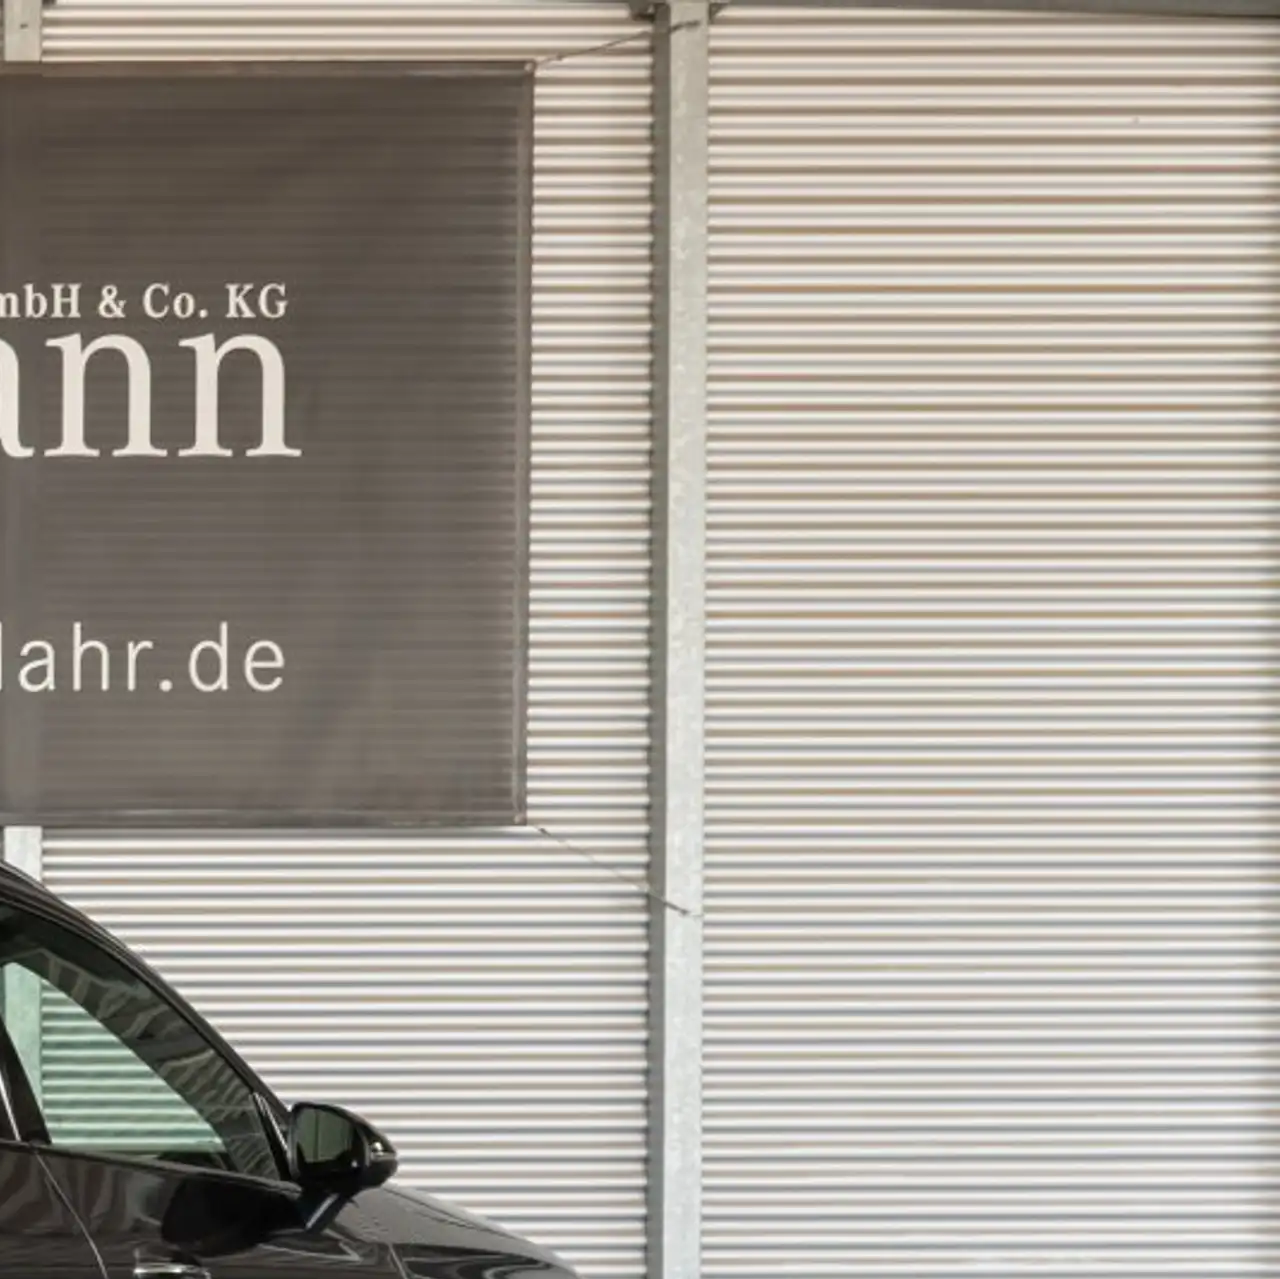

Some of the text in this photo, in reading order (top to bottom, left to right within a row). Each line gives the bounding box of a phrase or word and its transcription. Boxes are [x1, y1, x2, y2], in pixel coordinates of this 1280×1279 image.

[97, 284, 127, 319] &
[142, 282, 209, 319] Co.
[225, 283, 288, 319] KG
